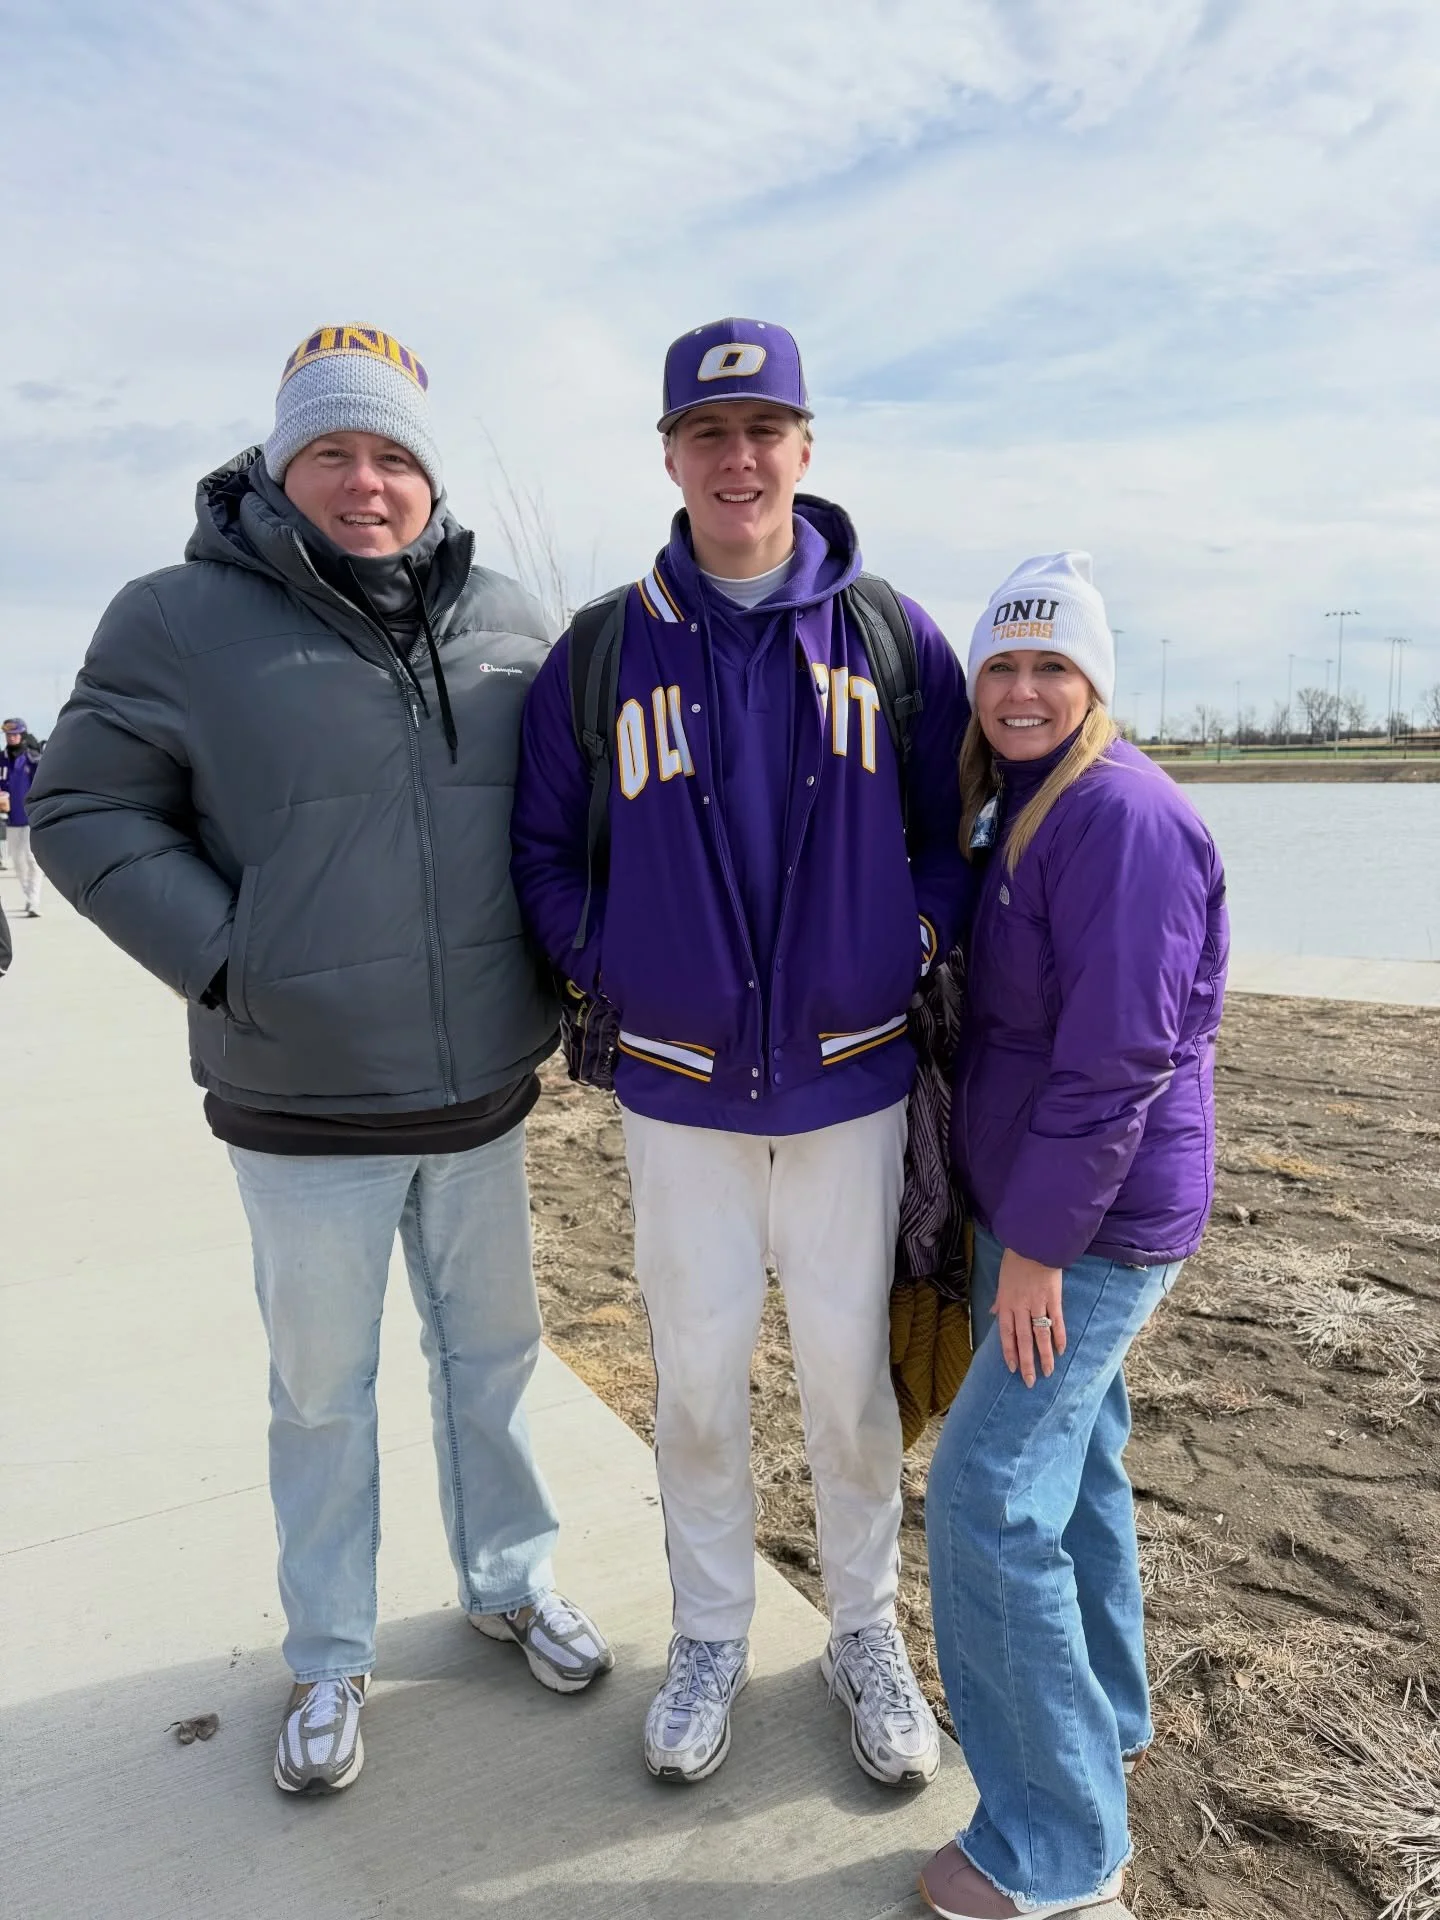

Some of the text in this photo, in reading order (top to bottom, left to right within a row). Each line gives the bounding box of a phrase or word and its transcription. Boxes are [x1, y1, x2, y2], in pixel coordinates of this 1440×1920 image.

[697, 343, 766, 381] O
[993, 599, 1059, 626] ONU
[991, 621, 1054, 642] TIGERS
